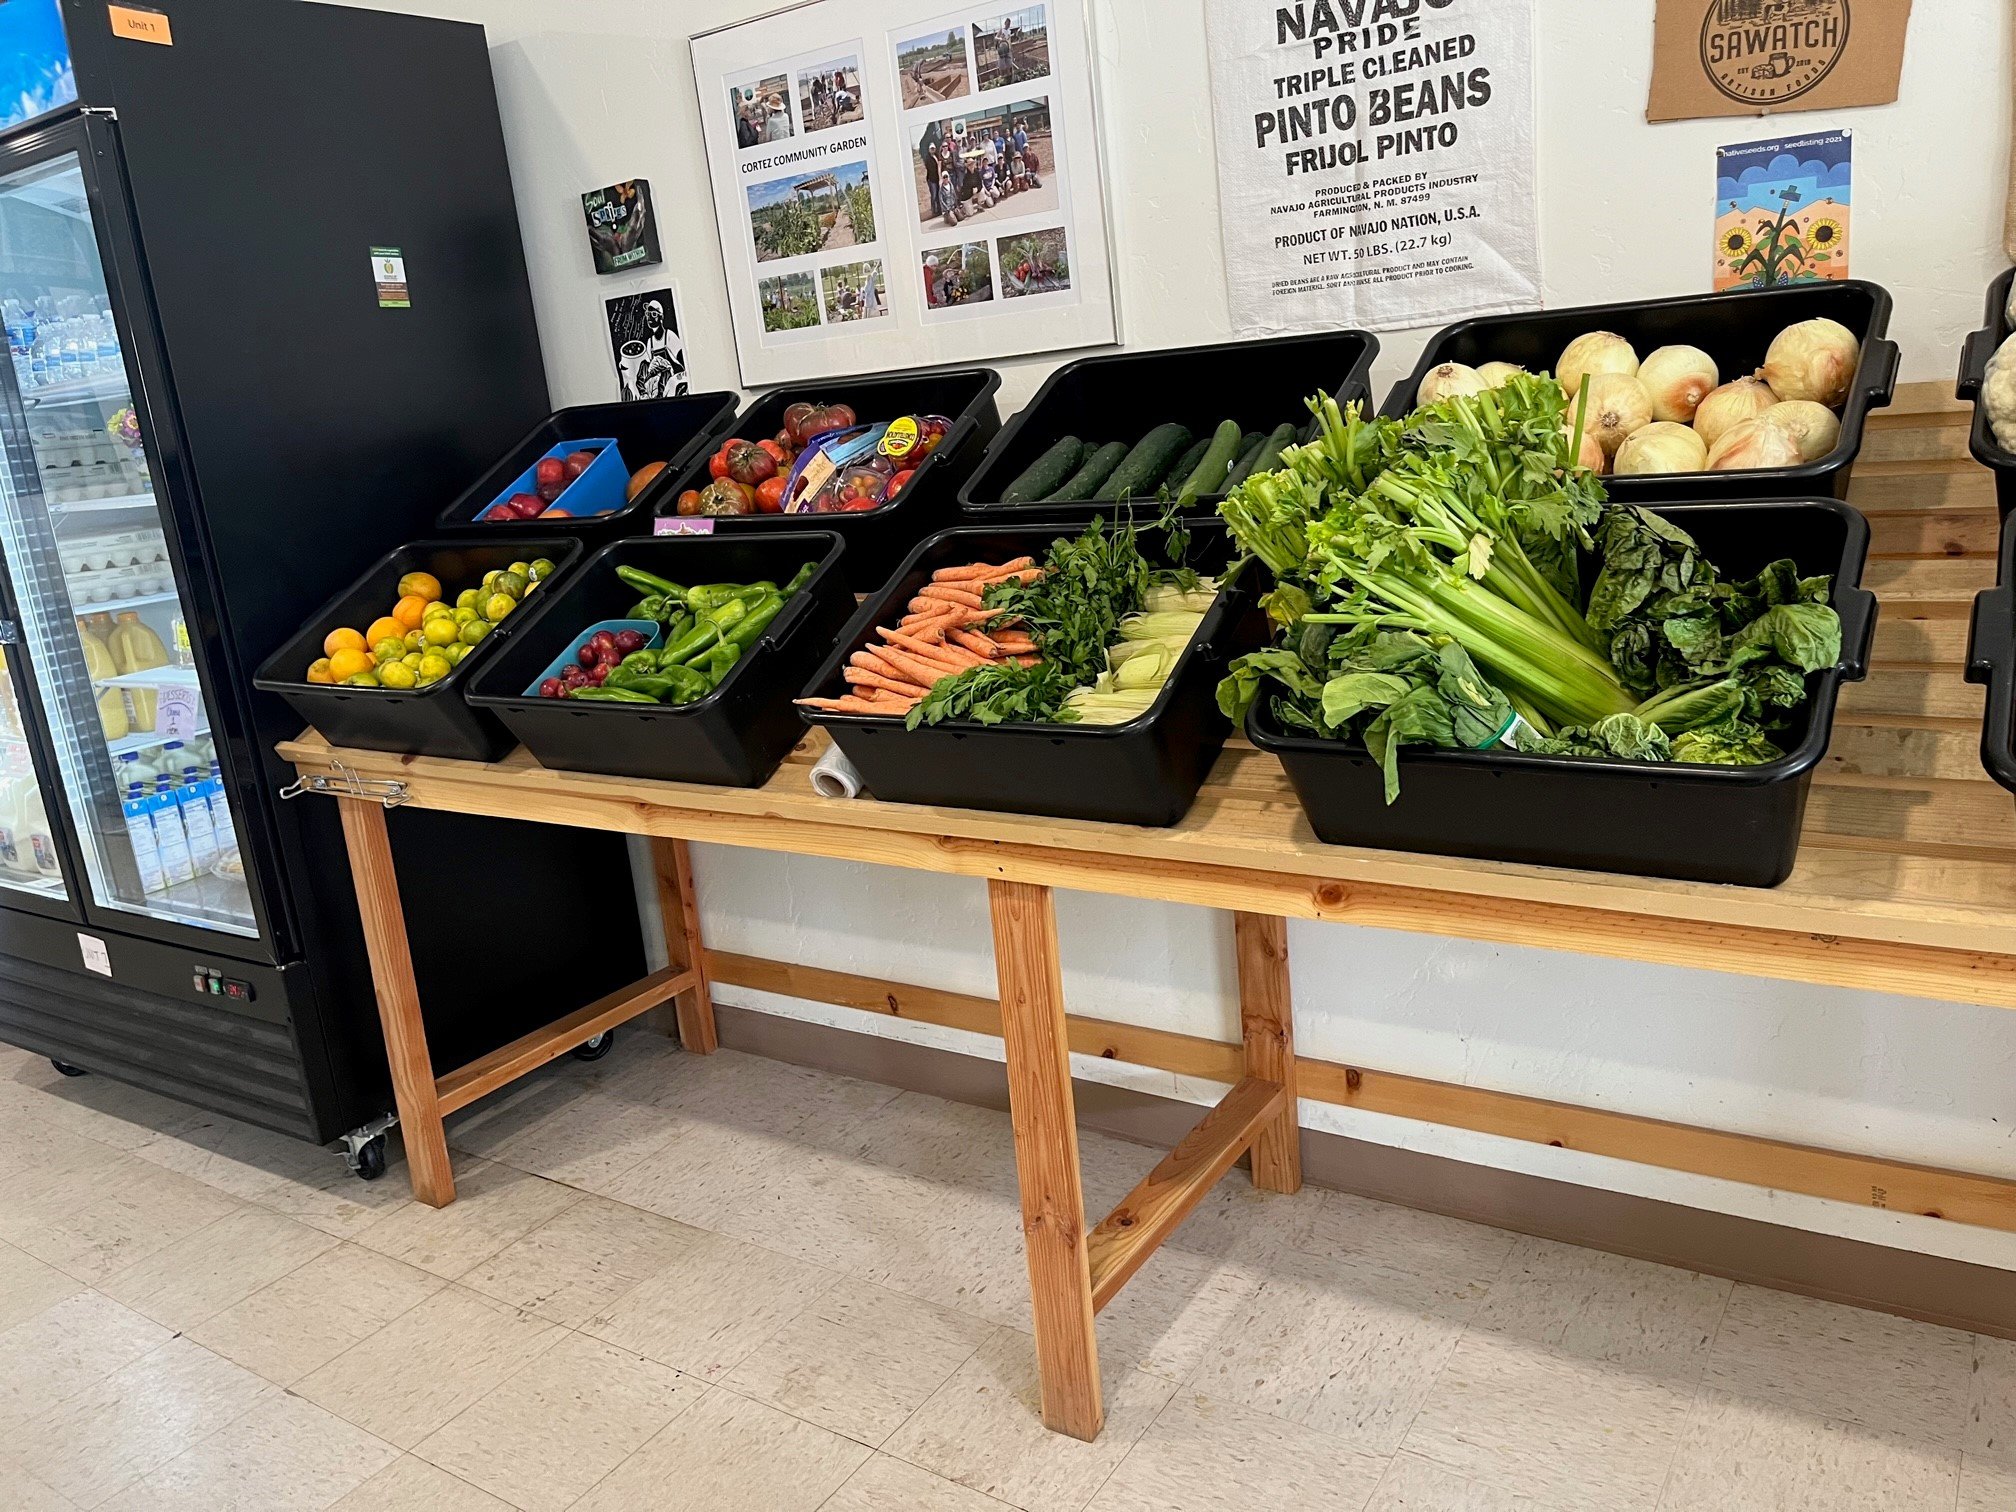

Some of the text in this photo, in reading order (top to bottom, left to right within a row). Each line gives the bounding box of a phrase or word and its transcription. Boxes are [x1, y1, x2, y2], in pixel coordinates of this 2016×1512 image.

[127, 18, 156, 32] Unit 1
[1276, 0, 1451, 45] NAVA
[1313, 16, 1421, 60] PRIDE
[1710, 16, 1838, 64] SAWATCH
[1274, 34, 1475, 99] TRIPLE CLEANED
[1720, 59, 1826, 97] ARTISAN FOODS
[1255, 67, 1491, 149] PINTO BEANS
[741, 136, 867, 174] CORTEZ COMMUNITY GARDEN
[1286, 121, 1458, 176] FRIJOL PINTO
[1723, 144, 1779, 157] nativeseeds.org
[1824, 136, 1843, 144] 2021
[1270, 174, 1479, 215] NAVAJO AGRICULTURAL PRODUCTS INDUSTRY
[1315, 172, 1428, 198] PRODUCED & PACKED BY
[1313, 193, 1431, 219] FARMINGTON, N. M. 87499
[1275, 205, 1481, 249] PRODUCT OF NAVAJO NATION, U.S.A.
[1303, 232, 1452, 265] NET WT. 50 LBS. (22.7 kg)
[1382, 264, 1411, 274] PRODUCT
[1412, 262, 1425, 270] AND
[1441, 256, 1469, 265] CONTAIN
[1372, 276, 1384, 284] ALL
[1385, 271, 1413, 282] PRODUCT
[1414, 269, 1434, 278] PRIOR
[1435, 267, 1444, 275] TO
